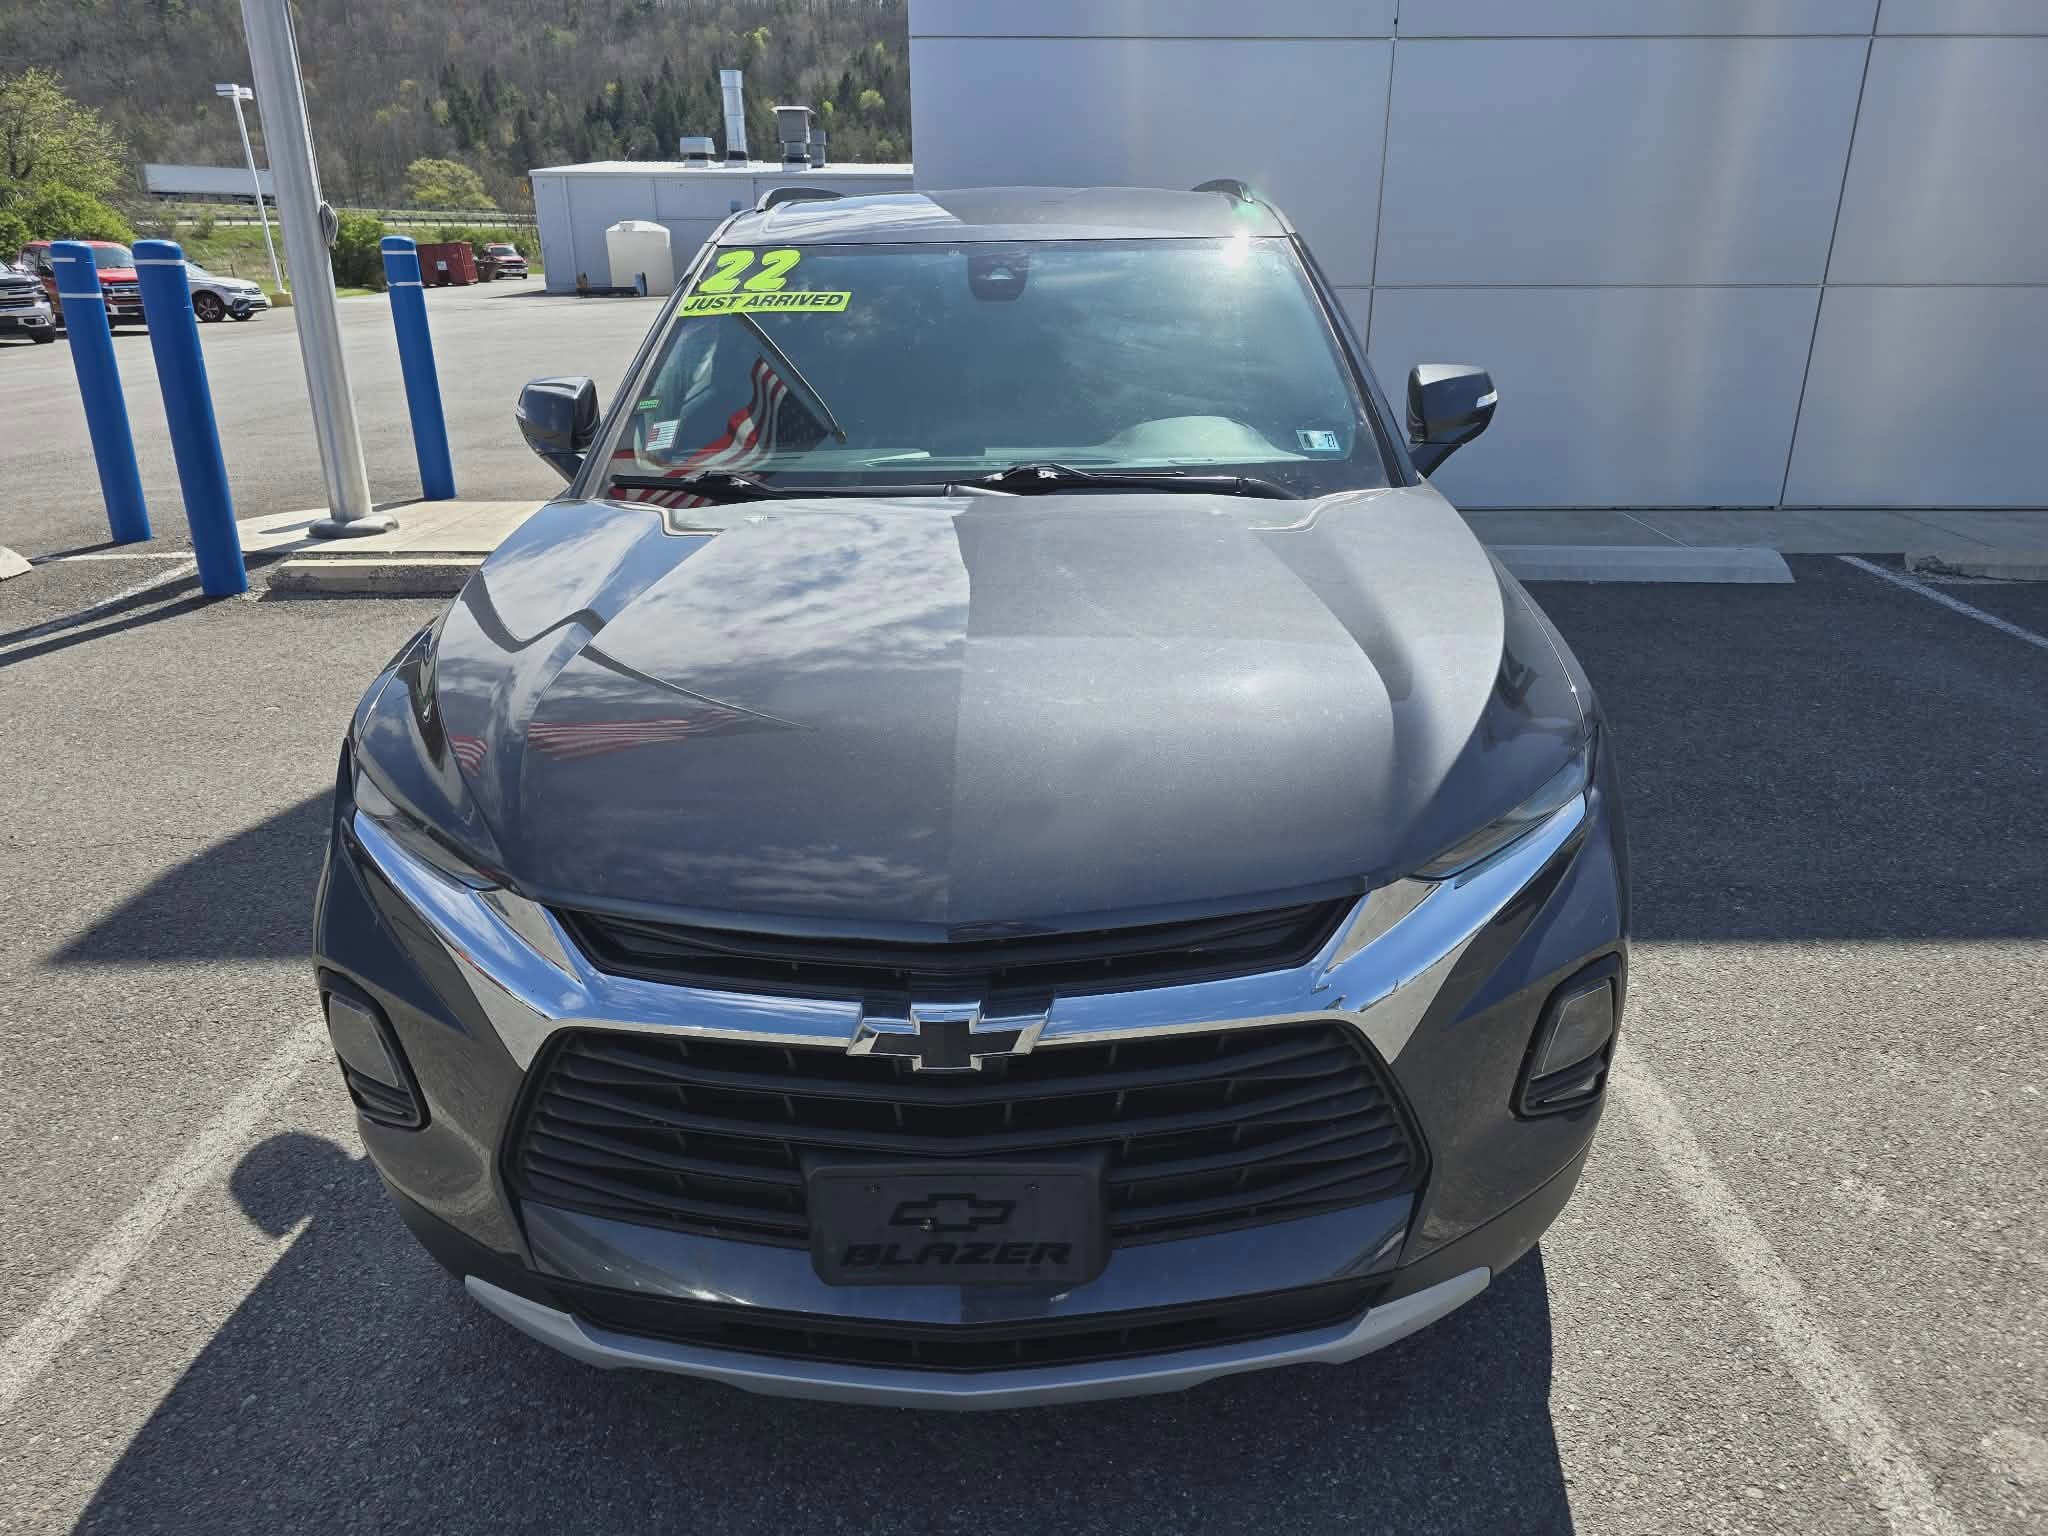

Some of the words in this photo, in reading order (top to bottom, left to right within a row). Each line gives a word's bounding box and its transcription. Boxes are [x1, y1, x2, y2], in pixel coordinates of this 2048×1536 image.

[699, 249, 801, 293] 22
[684, 296, 741, 311] JUST
[743, 294, 844, 307] ARRIVED
[840, 1243, 1073, 1265] BLAZER
